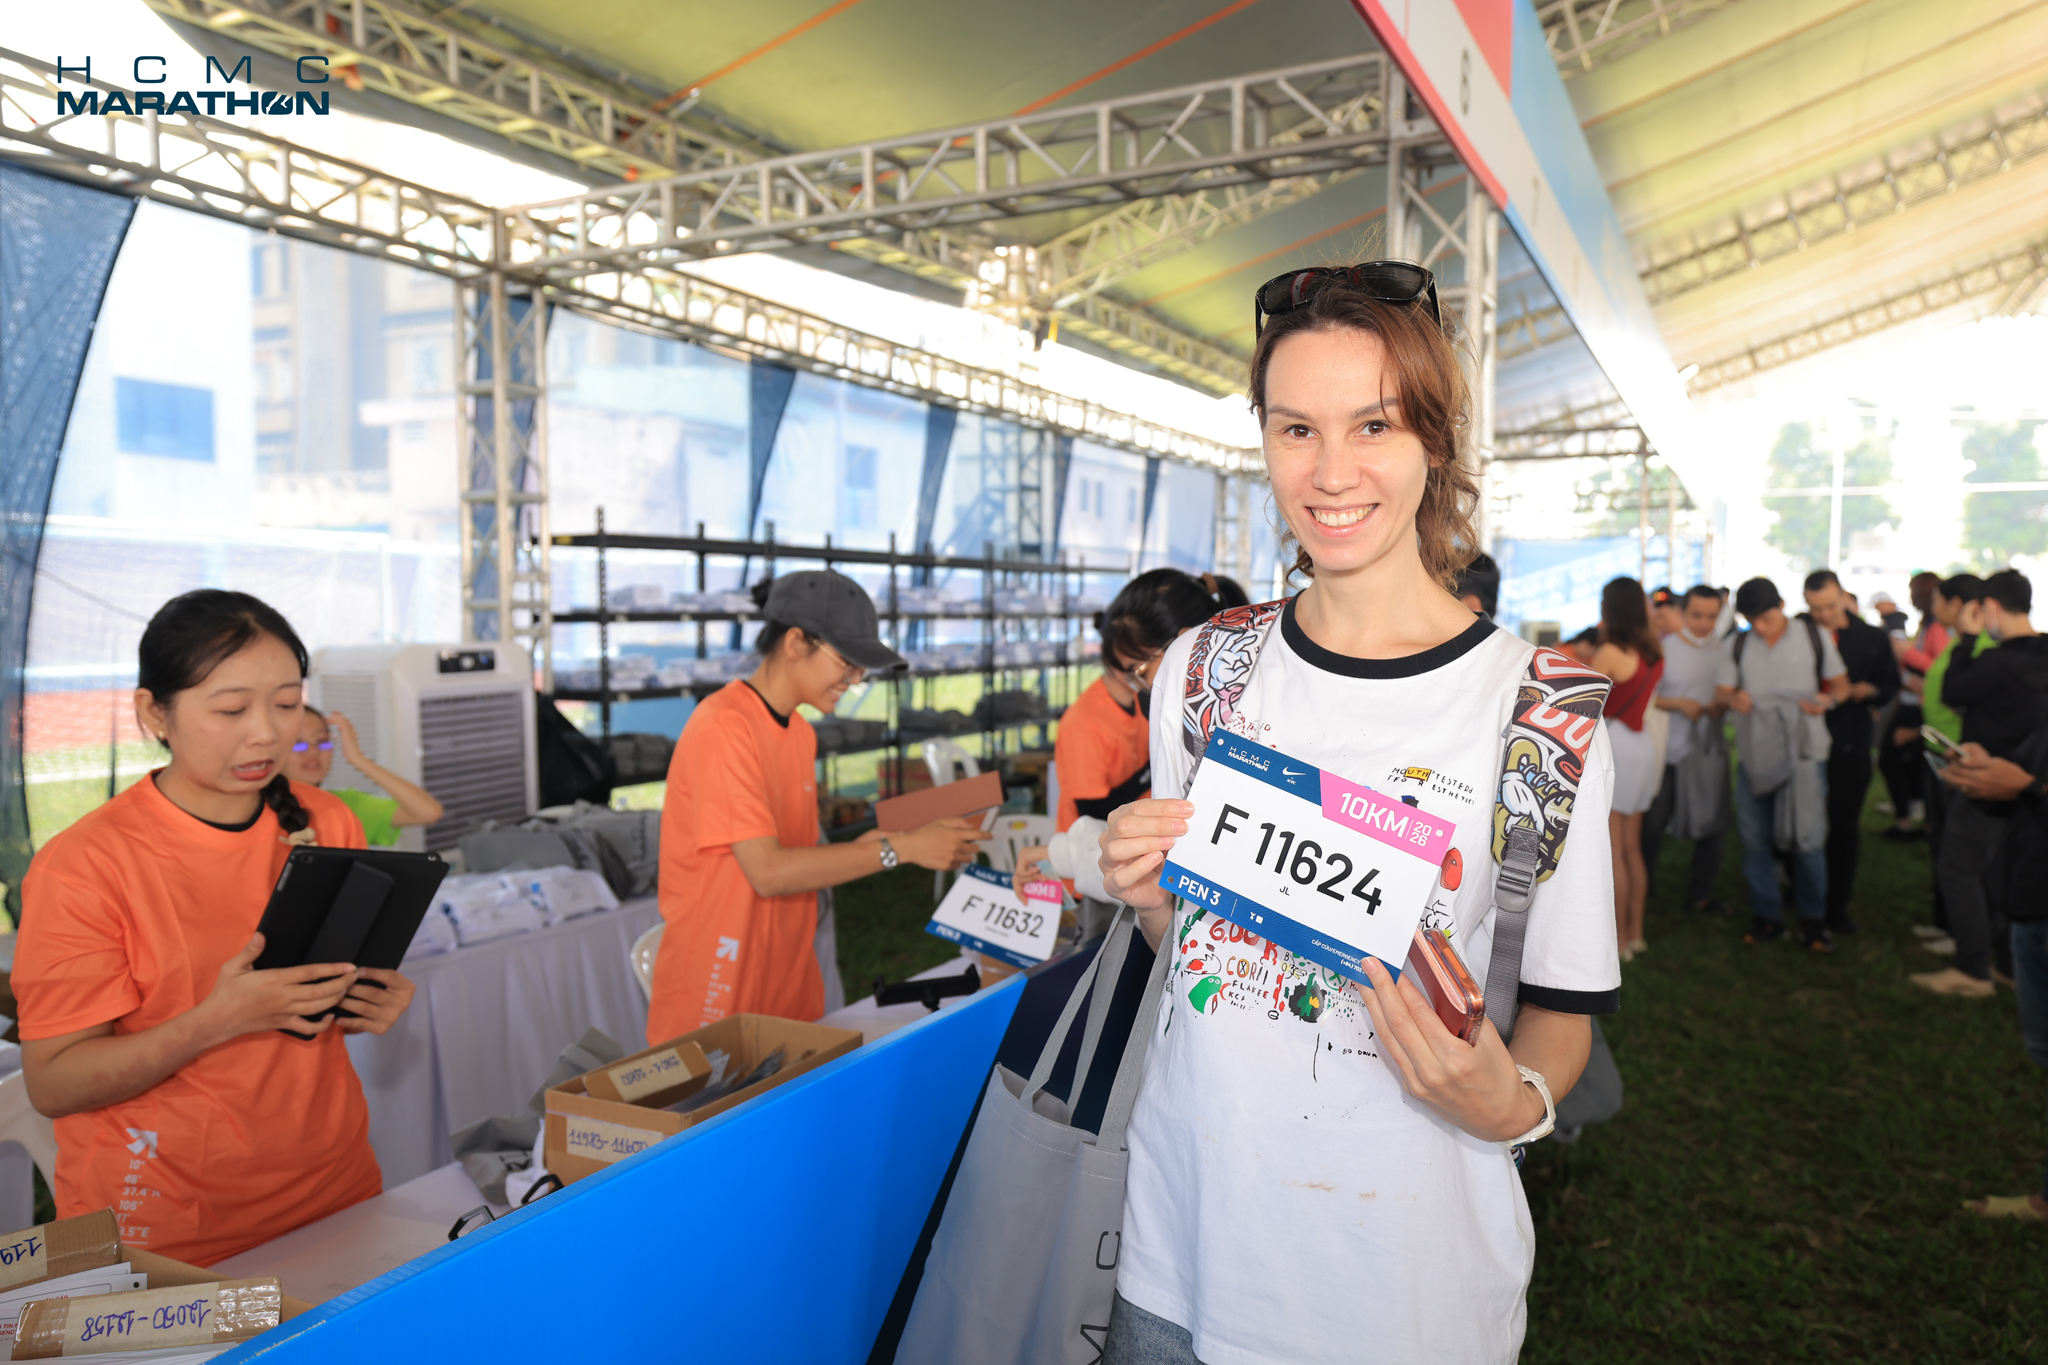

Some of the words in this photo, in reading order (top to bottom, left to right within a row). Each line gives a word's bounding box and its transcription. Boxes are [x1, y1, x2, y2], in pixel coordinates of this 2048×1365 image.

[1227, 751, 1269, 772] MARATHON
[1340, 792, 1410, 838] 10KM
[1409, 831, 1428, 847] 26
[1413, 821, 1432, 837] 20
[1211, 803, 1250, 845] F
[1255, 822, 1382, 916] 11624
[1178, 874, 1209, 901] PEN
[1209, 890, 1222, 906] 3
[1279, 886, 1290, 896] JL
[961, 894, 984, 914] F
[984, 902, 1044, 938] 11632
